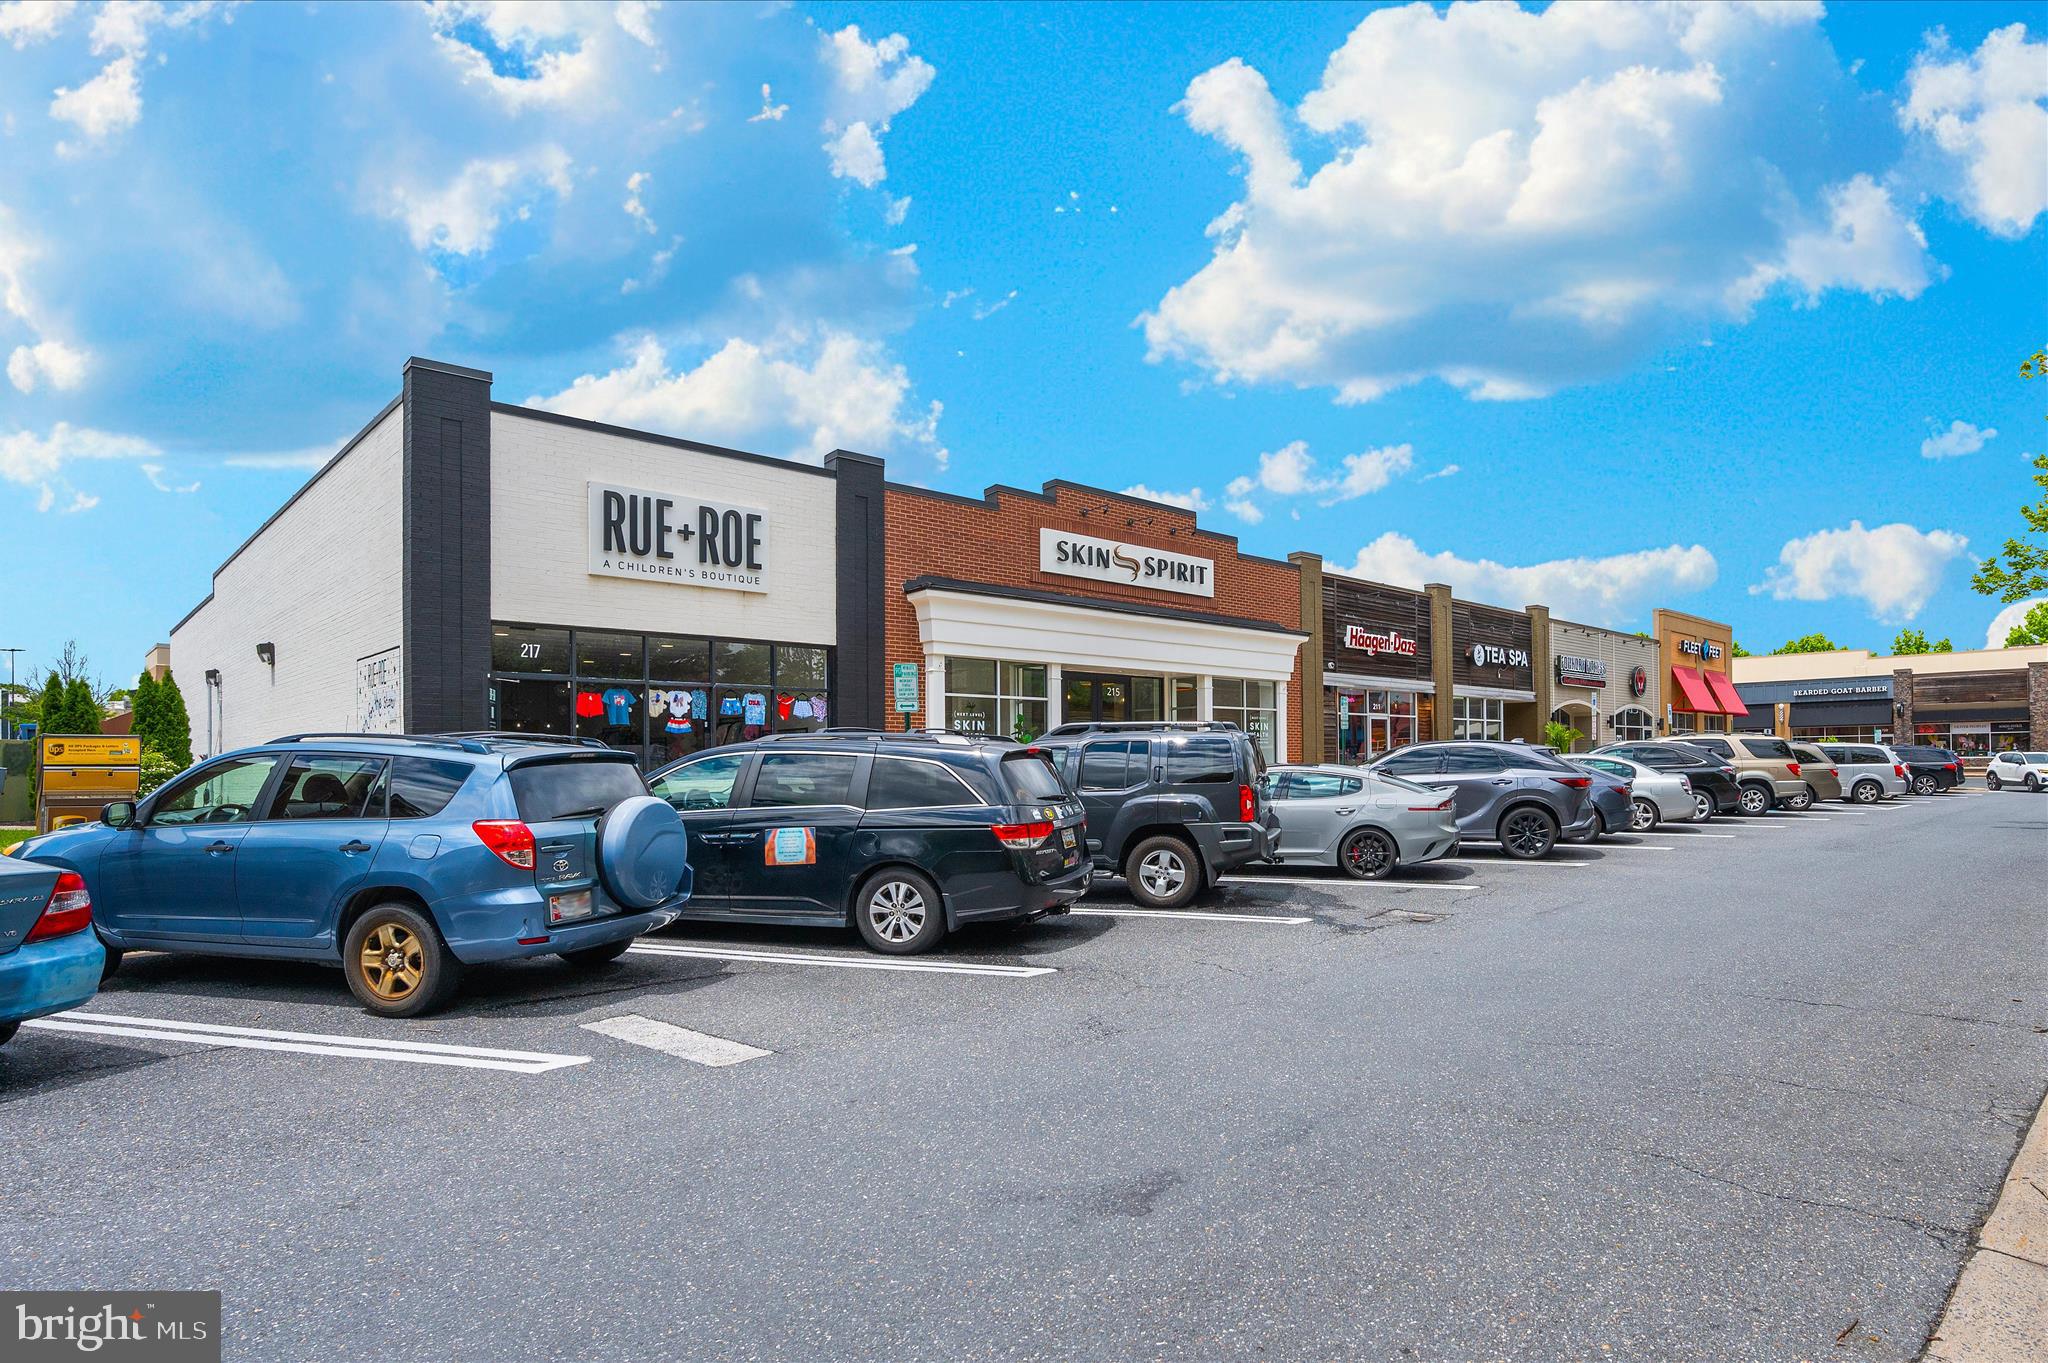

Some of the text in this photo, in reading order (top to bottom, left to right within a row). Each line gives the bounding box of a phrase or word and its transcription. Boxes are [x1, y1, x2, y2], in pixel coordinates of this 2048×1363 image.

[1057, 540, 1208, 585] SKIN SPIRIT
[603, 559, 761, 585] A CHILDREN'S BOUTIQUE
[520, 643, 541, 659] 217
[1484, 645, 1529, 667] TEA SPA
[1683, 640, 1722, 659] FLEET FEET
[1107, 687, 1121, 697] 215
[1793, 685, 1888, 697] BEARDED GOAT BARBER
[954, 719, 985, 731] SKIN
[1249, 722, 1269, 731] SKIN
[49, 745, 65, 754] ups
